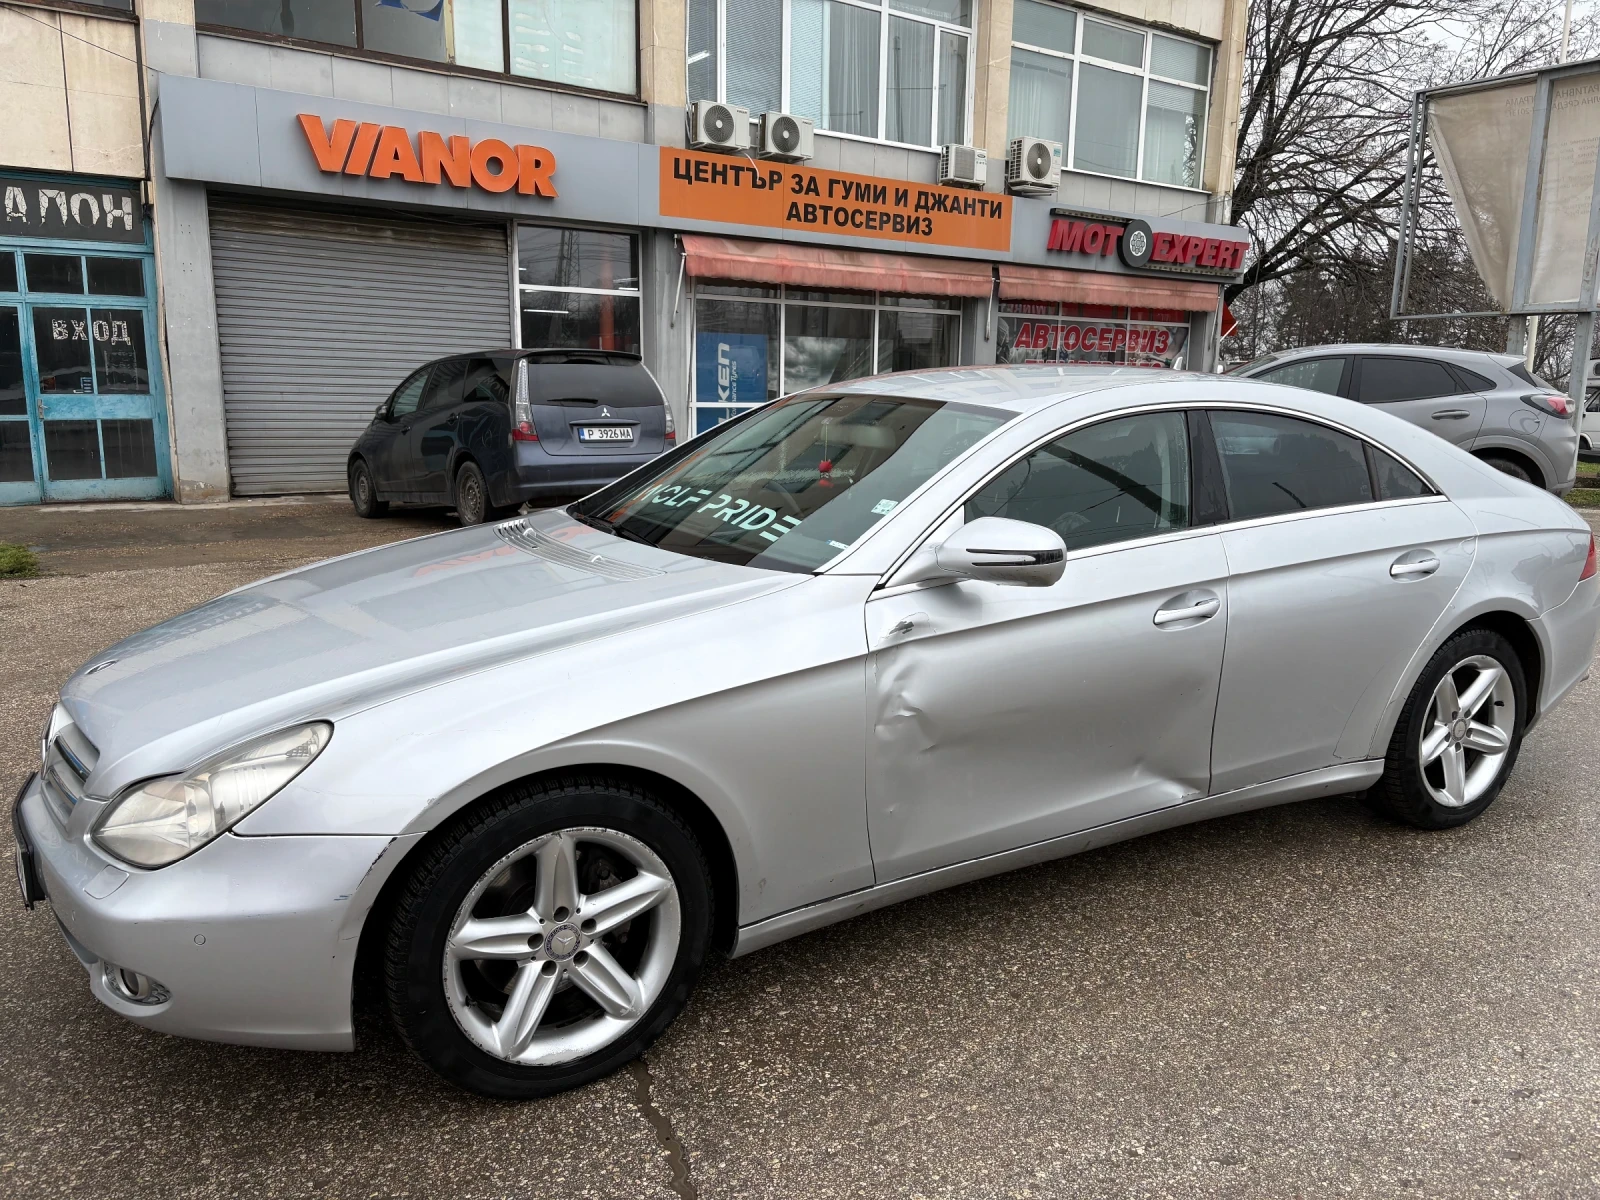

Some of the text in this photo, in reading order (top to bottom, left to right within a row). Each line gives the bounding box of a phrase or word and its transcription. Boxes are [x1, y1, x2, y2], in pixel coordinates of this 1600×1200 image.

[297, 114, 559, 198] VIANOR
[673, 157, 1003, 219] ЦЕНТЪР ЗА ГУМИ И ДЖАНТИ
[786, 202, 934, 237] АВТОСЕРВИЗ
[1150, 231, 1249, 269] EXPERT
[52, 319, 131, 345] ВХОД
[1014, 322, 1170, 355] АВТОСЕРВИЗ
[697, 494, 803, 543] PRIDE
